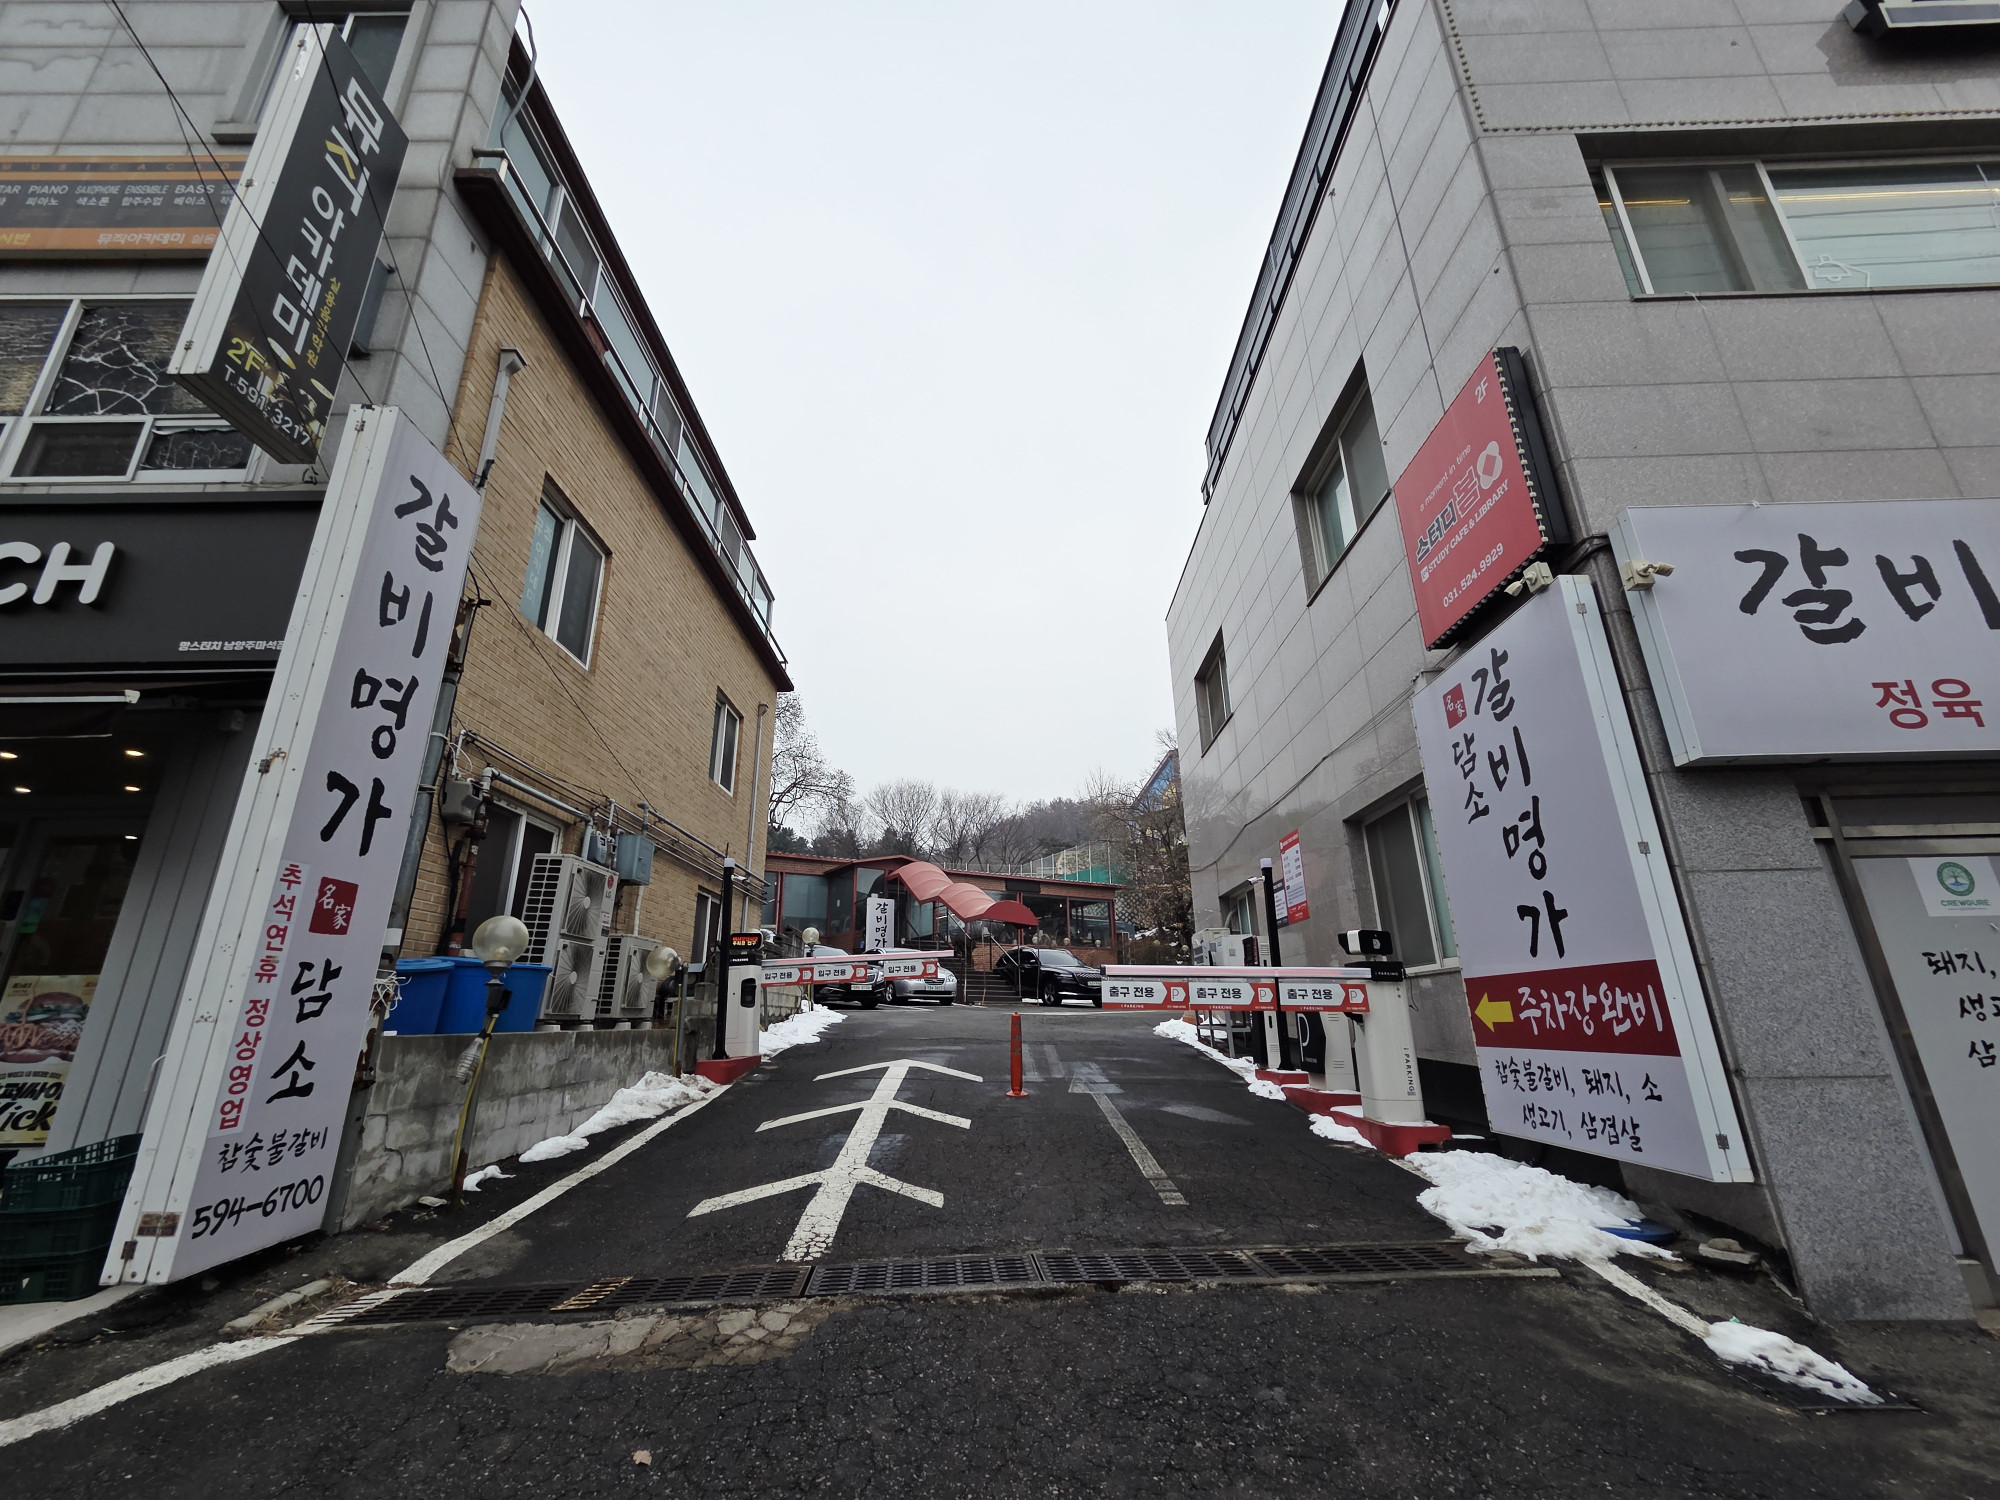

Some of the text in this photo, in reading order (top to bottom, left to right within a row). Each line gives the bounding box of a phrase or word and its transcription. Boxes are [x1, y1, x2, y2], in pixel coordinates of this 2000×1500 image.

[25, 197, 59, 207] 피아노
[173, 196, 207, 206] 베이스
[28, 185, 69, 195] PIANO
[174, 185, 215, 194] BASS
[226, 337, 265, 372] 2F
[1474, 376, 1490, 404] 2F
[1448, 464, 1456, 476] in
[1456, 444, 1471, 466] time
[1428, 479, 1509, 573] STUDY CAFE & LIBRARY
[1443, 542, 1504, 608] 031.524.9929
[1733, 533, 2000, 645] 갈비
[320, 474, 459, 857] 갈비명가
[1870, 678, 1986, 730] 정육
[1451, 732, 1490, 825] 담소
[1471, 647, 1569, 959] 갈비명가
[874, 902, 889, 949] 갈비명가
[764, 971, 793, 980] 입구 전용
[818, 968, 847, 977] 입구 전용
[888, 965, 917, 974] 입구 전용
[218, 863, 304, 1131] 추석연휴 정상영업
[1109, 986, 1155, 998] 출구 전용
[1196, 987, 1242, 999] 출구 전용
[1287, 988, 1333, 1000] 출구 전용
[1517, 981, 1663, 1037] 주차장완비
[265, 957, 343, 1105] 담소
[1968, 1040, 1997, 1068] 삼
[1641, 1072, 1663, 1102] 소
[218, 1127, 330, 1175] 참숯불갈비
[1580, 1111, 1643, 1153] 삼겹살
[191, 1175, 325, 1241] 594-6700
